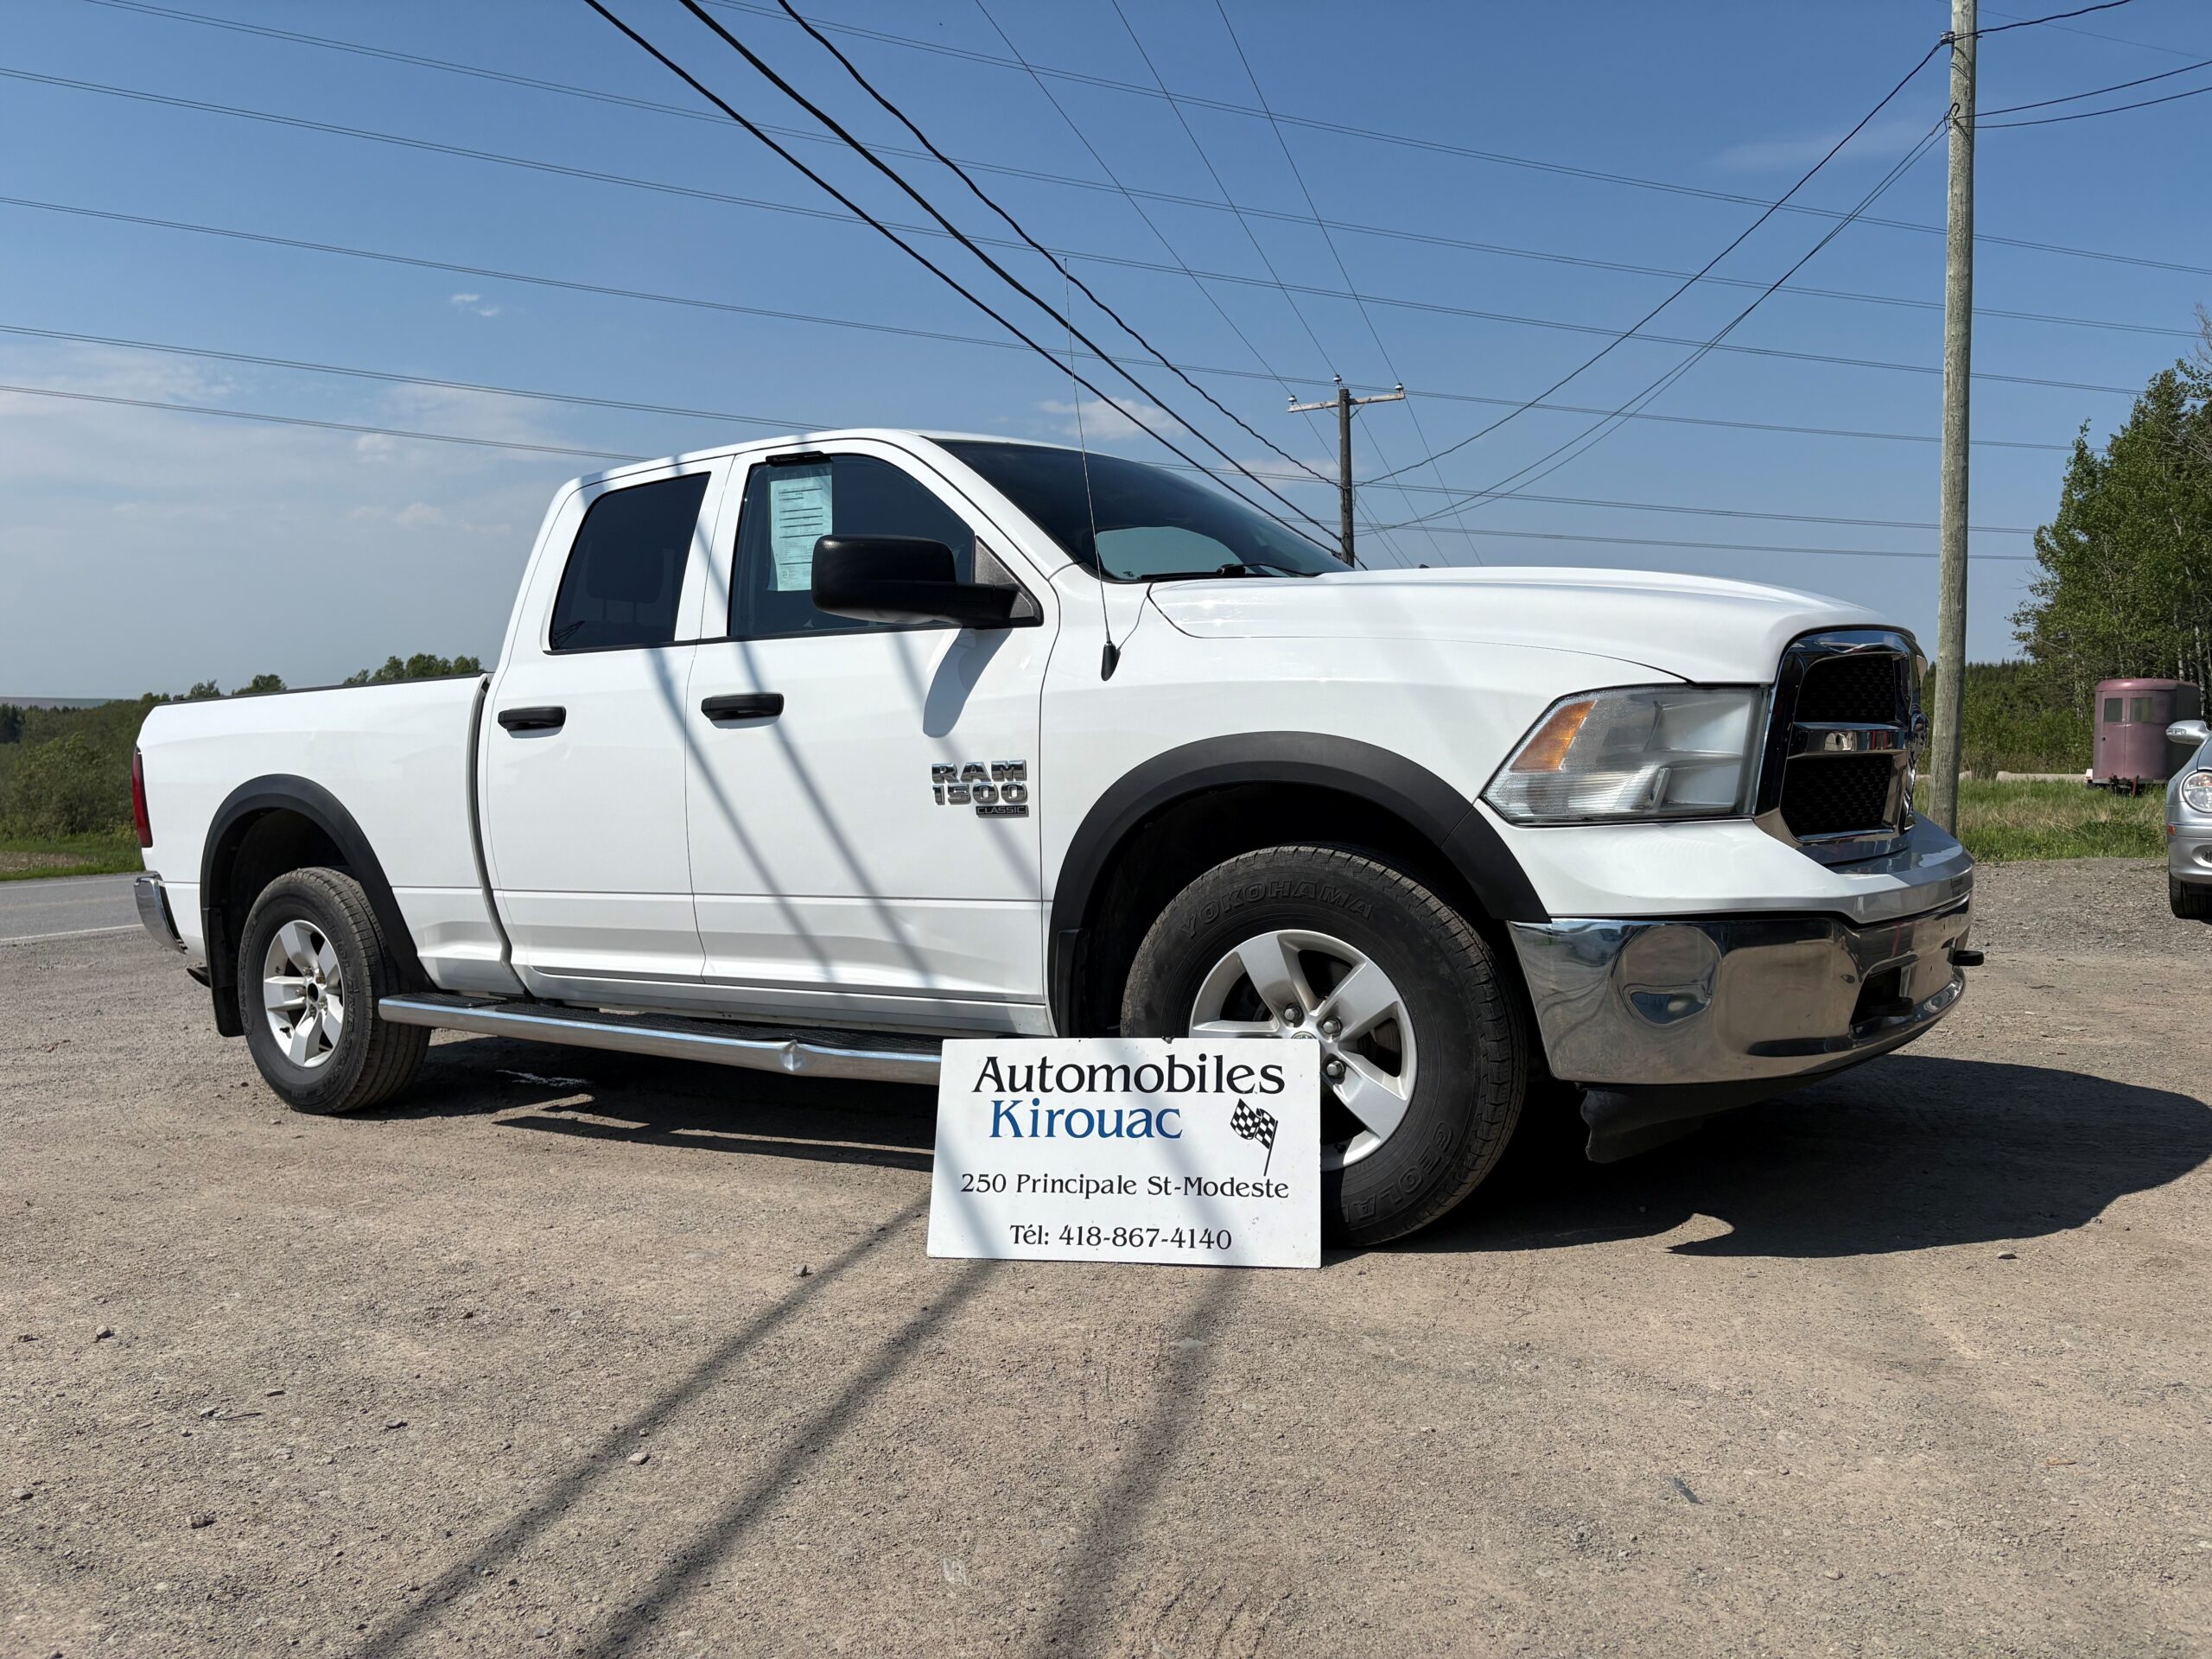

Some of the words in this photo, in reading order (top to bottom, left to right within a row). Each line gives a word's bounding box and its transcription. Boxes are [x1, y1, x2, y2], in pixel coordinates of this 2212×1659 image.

[931, 760, 1028, 783] RAM
[932, 781, 1028, 805] 1500
[977, 806, 1027, 815] CLASSIC
[1180, 880, 1374, 938] YOKOHAMA
[971, 1052, 1286, 1094] Automobiles
[989, 1097, 1183, 1139] Kirouac
[961, 1173, 1007, 1193] 250
[1016, 1173, 1137, 1199] Principale
[1147, 1176, 1289, 1198] St-Modeste
[1009, 1224, 1050, 1246] Tél:
[1058, 1225, 1232, 1250] 418-867-4140
